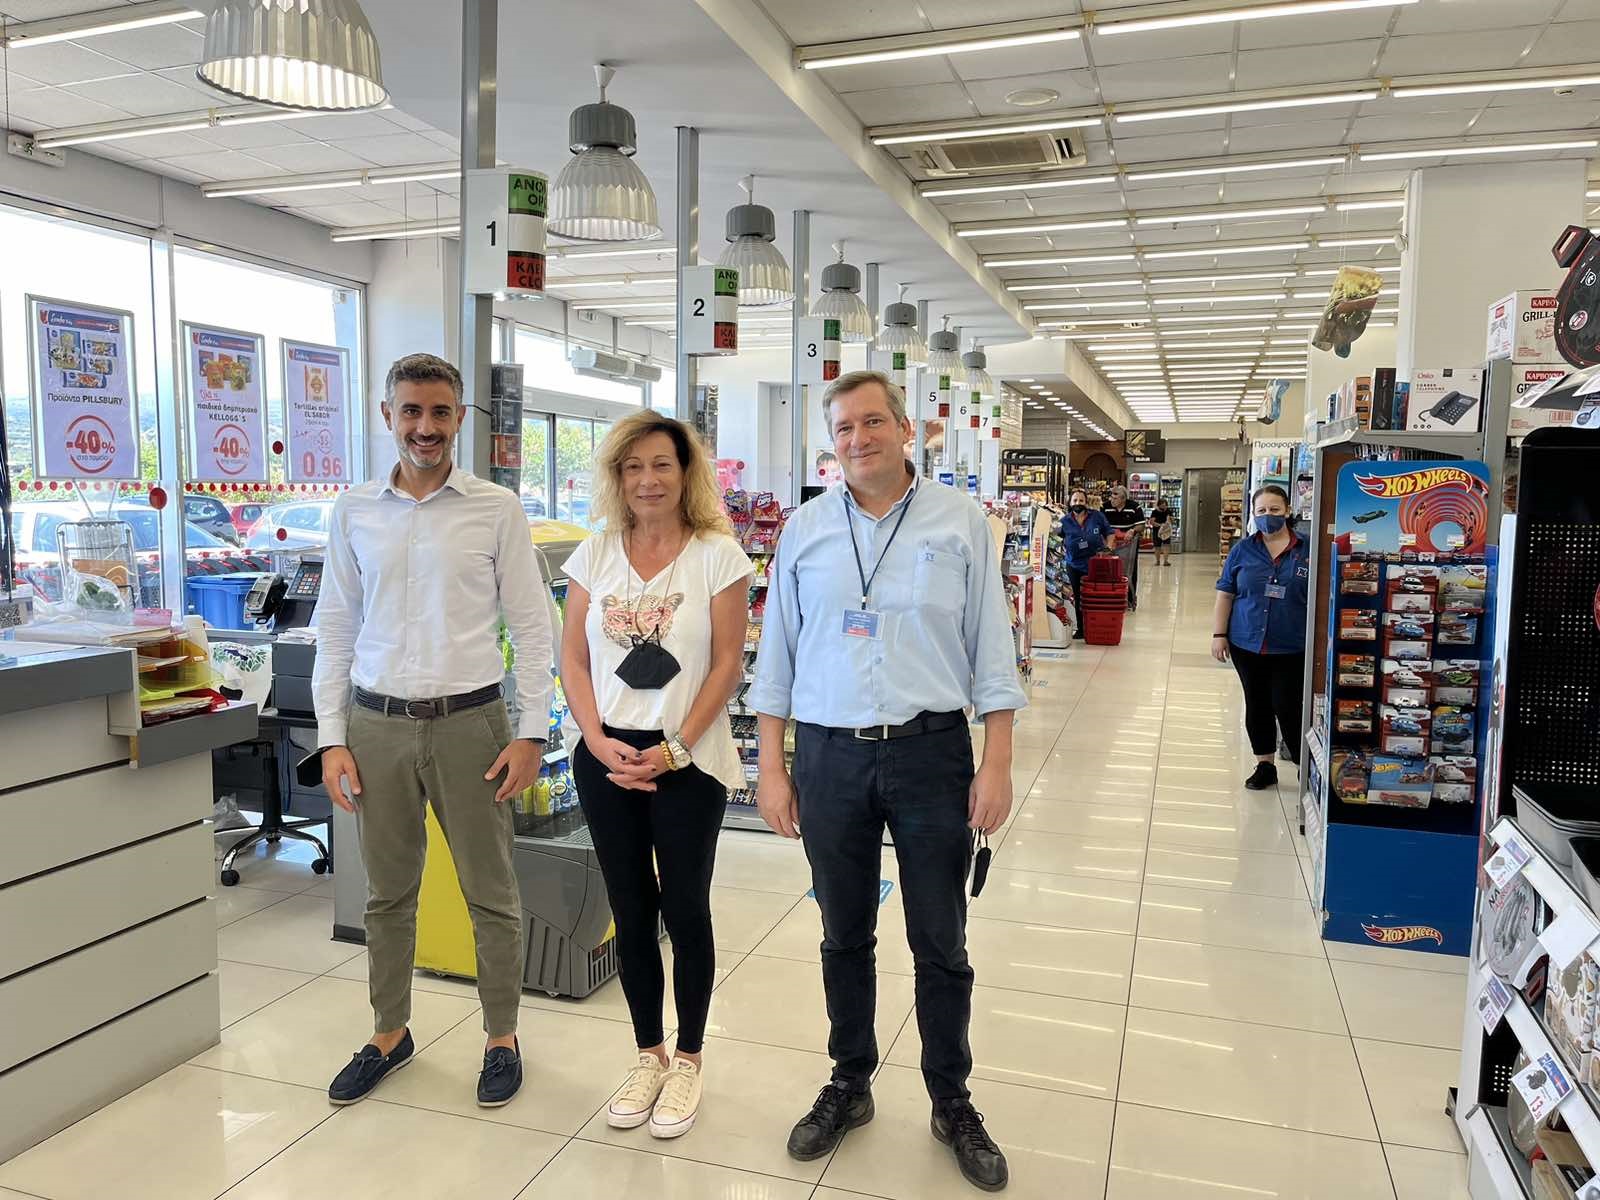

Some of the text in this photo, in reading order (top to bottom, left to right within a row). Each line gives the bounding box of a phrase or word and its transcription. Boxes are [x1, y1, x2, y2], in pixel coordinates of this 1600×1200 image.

[486, 220, 496, 246] 1
[693, 298, 705, 317] 2
[1532, 297, 1557, 308] ΚΑΡΒΟ
[1522, 310, 1556, 323] GRILL-
[807, 343, 817, 358] 3
[82, 395, 123, 406] PILLSBURY
[928, 392, 937, 402] 5
[960, 405, 967, 415] 6
[982, 416, 988, 427] 7
[66, 430, 116, 454] -40%
[303, 451, 342, 478] 0.96
[1381, 476, 1414, 497] HOT
[1380, 928, 1404, 942] HOT
